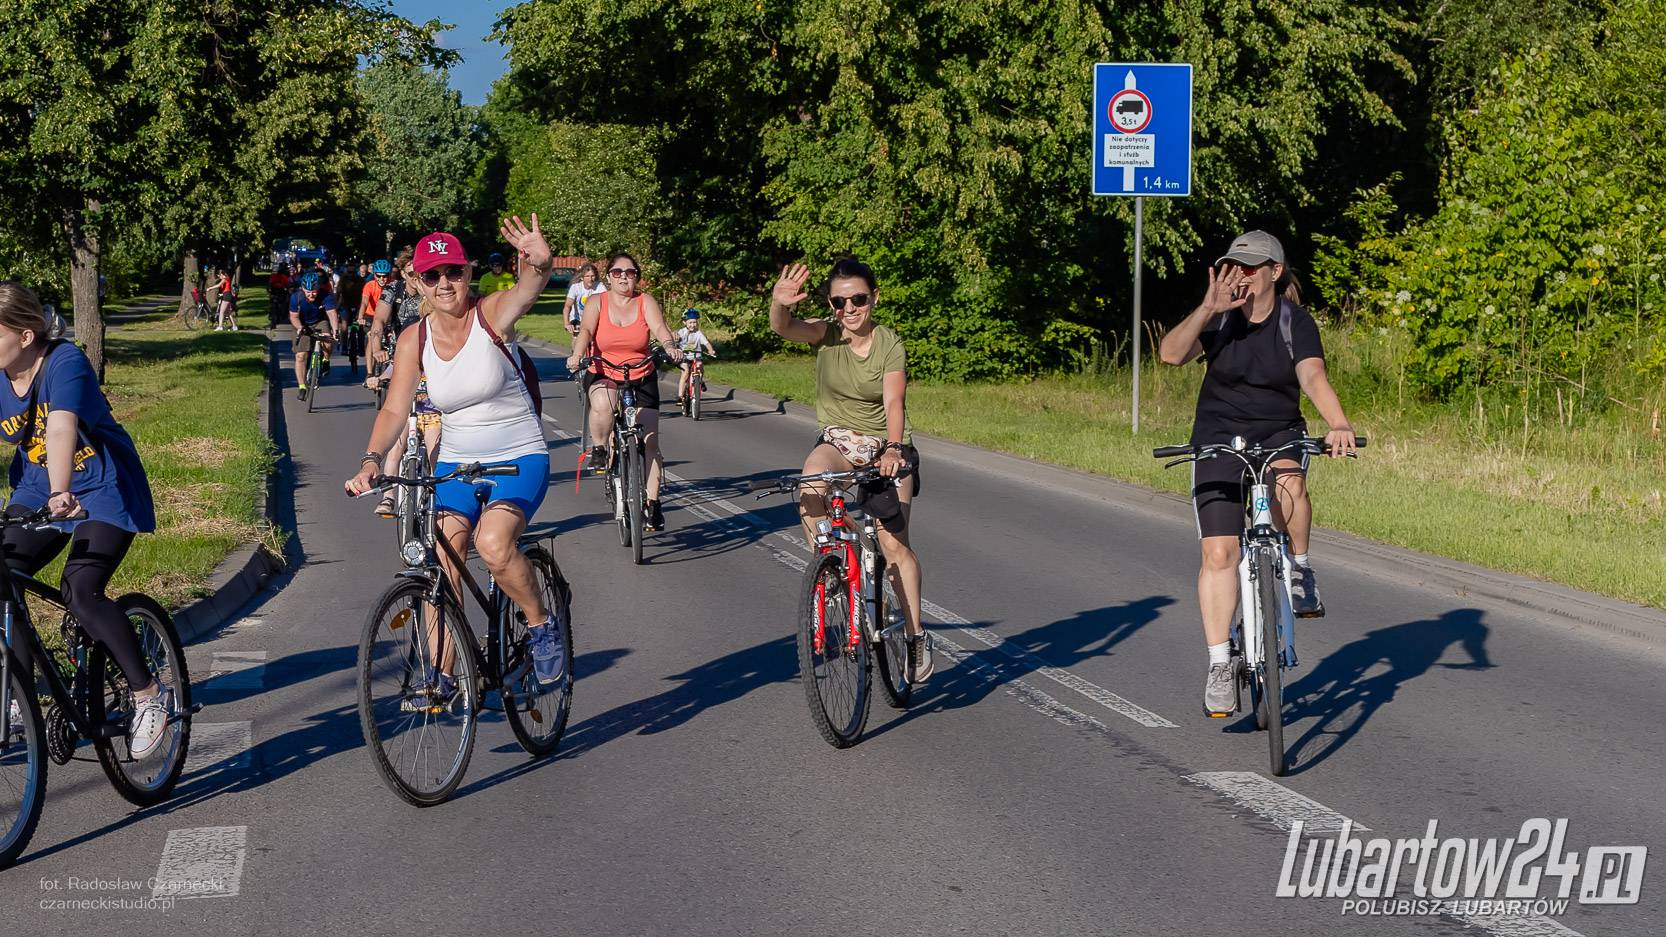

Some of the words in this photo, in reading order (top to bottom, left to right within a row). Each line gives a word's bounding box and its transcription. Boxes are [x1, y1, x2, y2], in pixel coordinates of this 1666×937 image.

[1143, 176, 1162, 190] 1,4
[1165, 180, 1180, 189] km
[427, 239, 449, 255] NY
